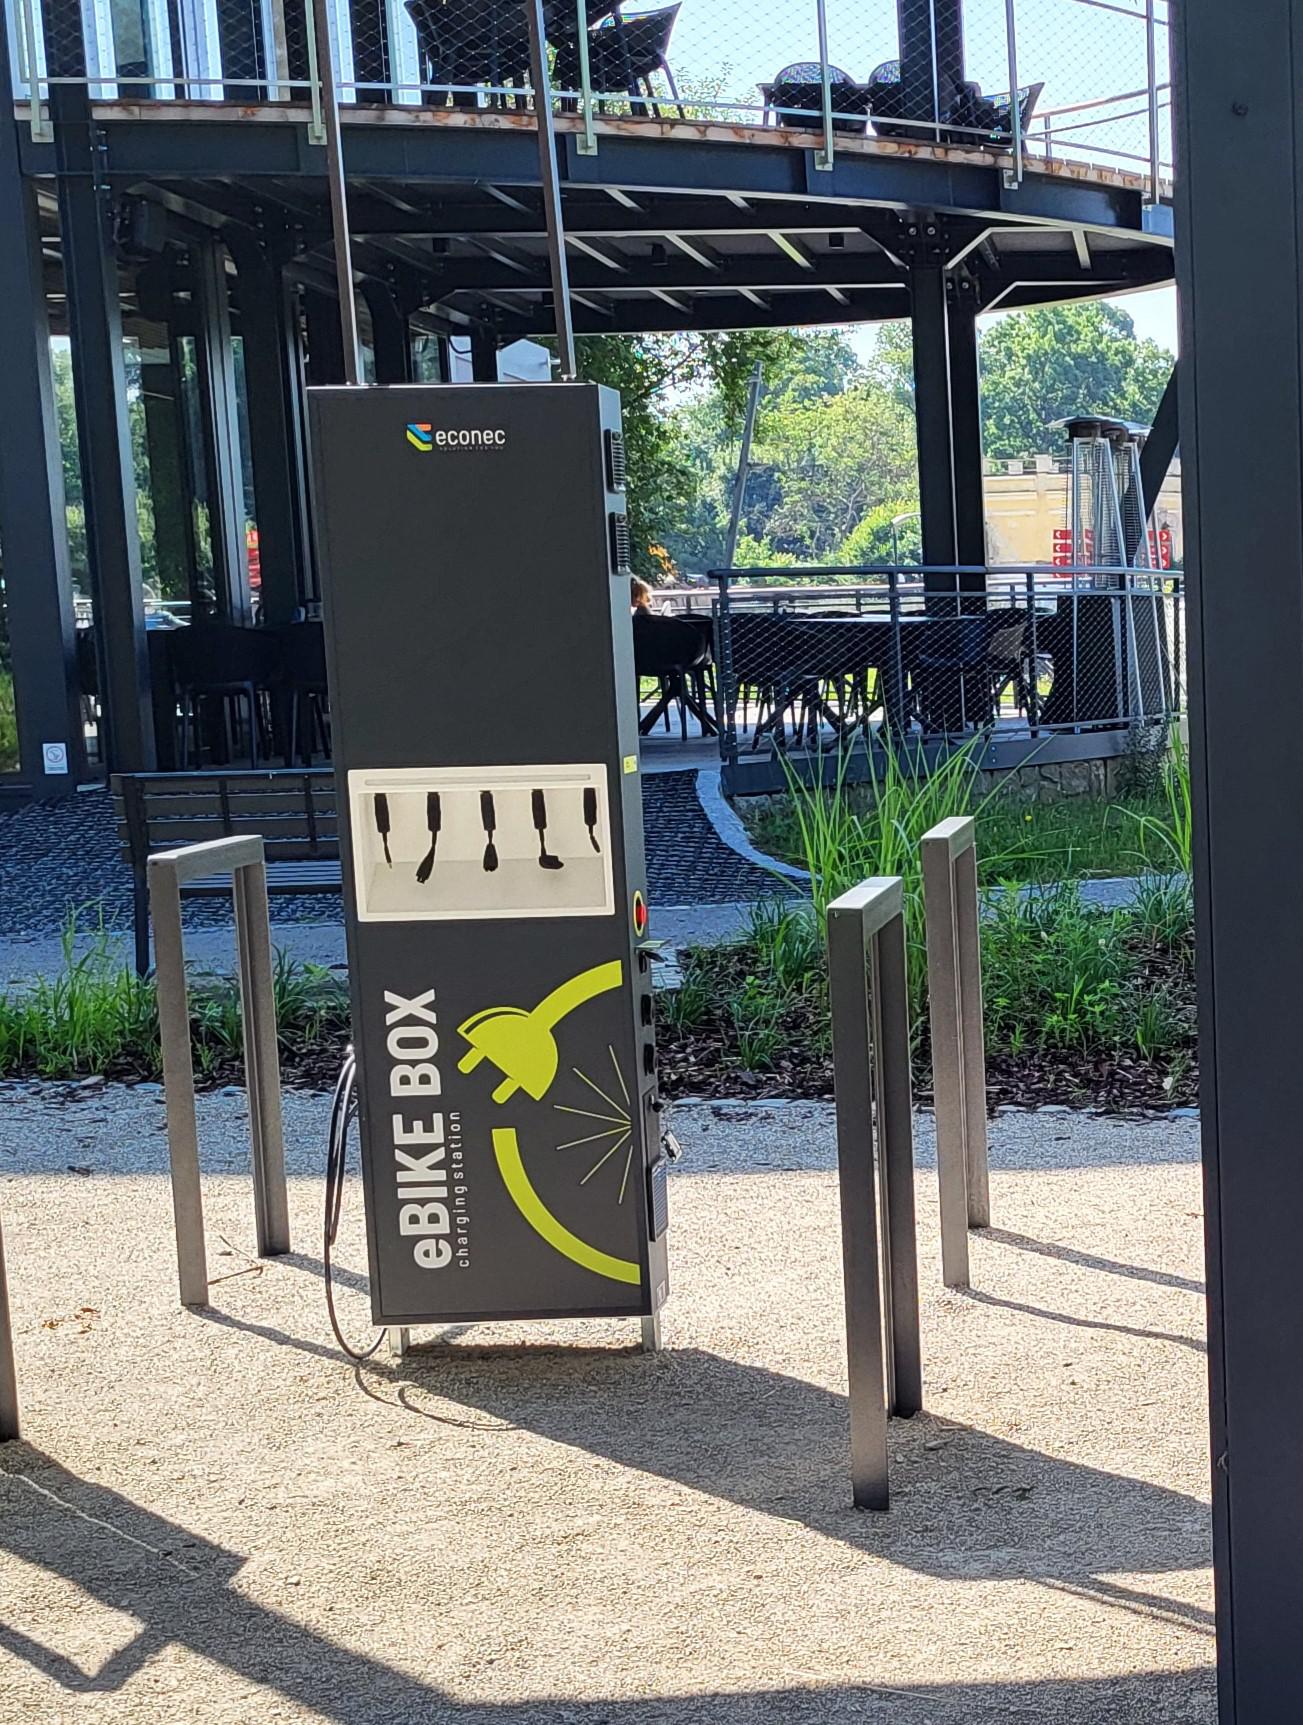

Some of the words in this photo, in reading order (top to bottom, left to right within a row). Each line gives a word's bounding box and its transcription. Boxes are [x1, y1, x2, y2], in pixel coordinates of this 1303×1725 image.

[435, 429, 506, 446] econec
[384, 988, 442, 1097] BOX
[449, 1111, 464, 1180] station
[392, 1112, 452, 1269] eBIKE
[453, 1185, 470, 1268] charging
